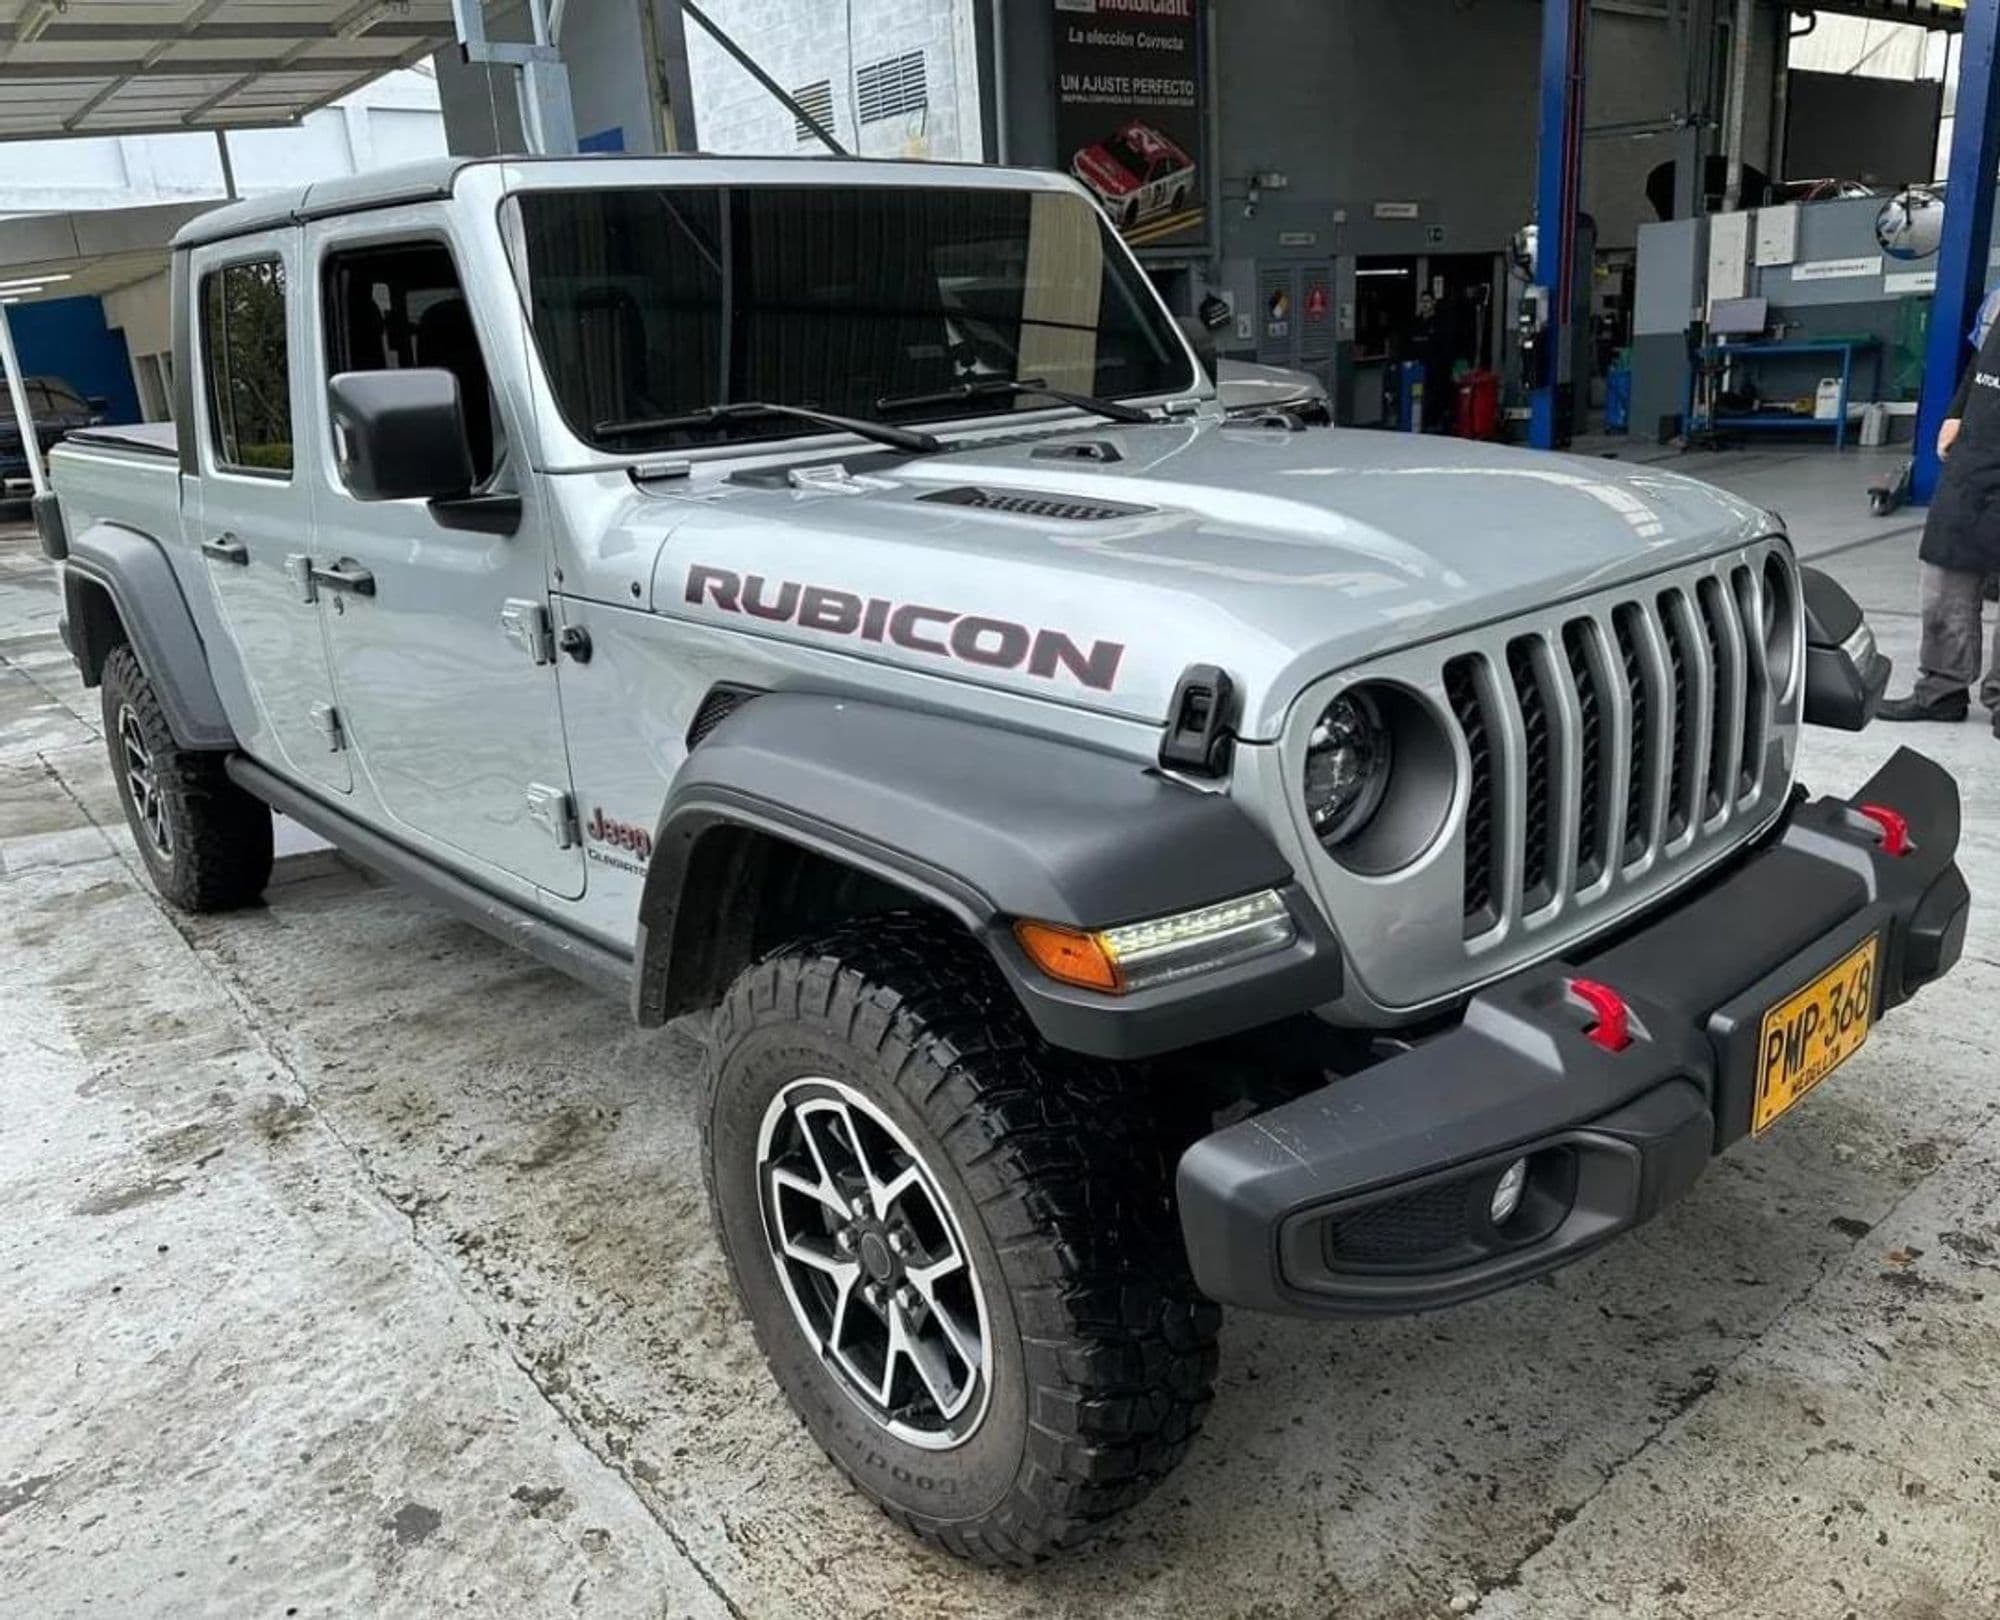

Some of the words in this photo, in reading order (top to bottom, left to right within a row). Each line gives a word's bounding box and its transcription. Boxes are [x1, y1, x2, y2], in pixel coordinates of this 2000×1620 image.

[1068, 26, 1083, 43] La
[1137, 32, 1184, 51] Correcta
[1061, 74, 1079, 91] UN
[1082, 77, 1129, 93] AJUSTE
[1133, 79, 1194, 96] PERFECTO
[685, 564, 1125, 691] RUBICON
[586, 806, 652, 862] Jeep
